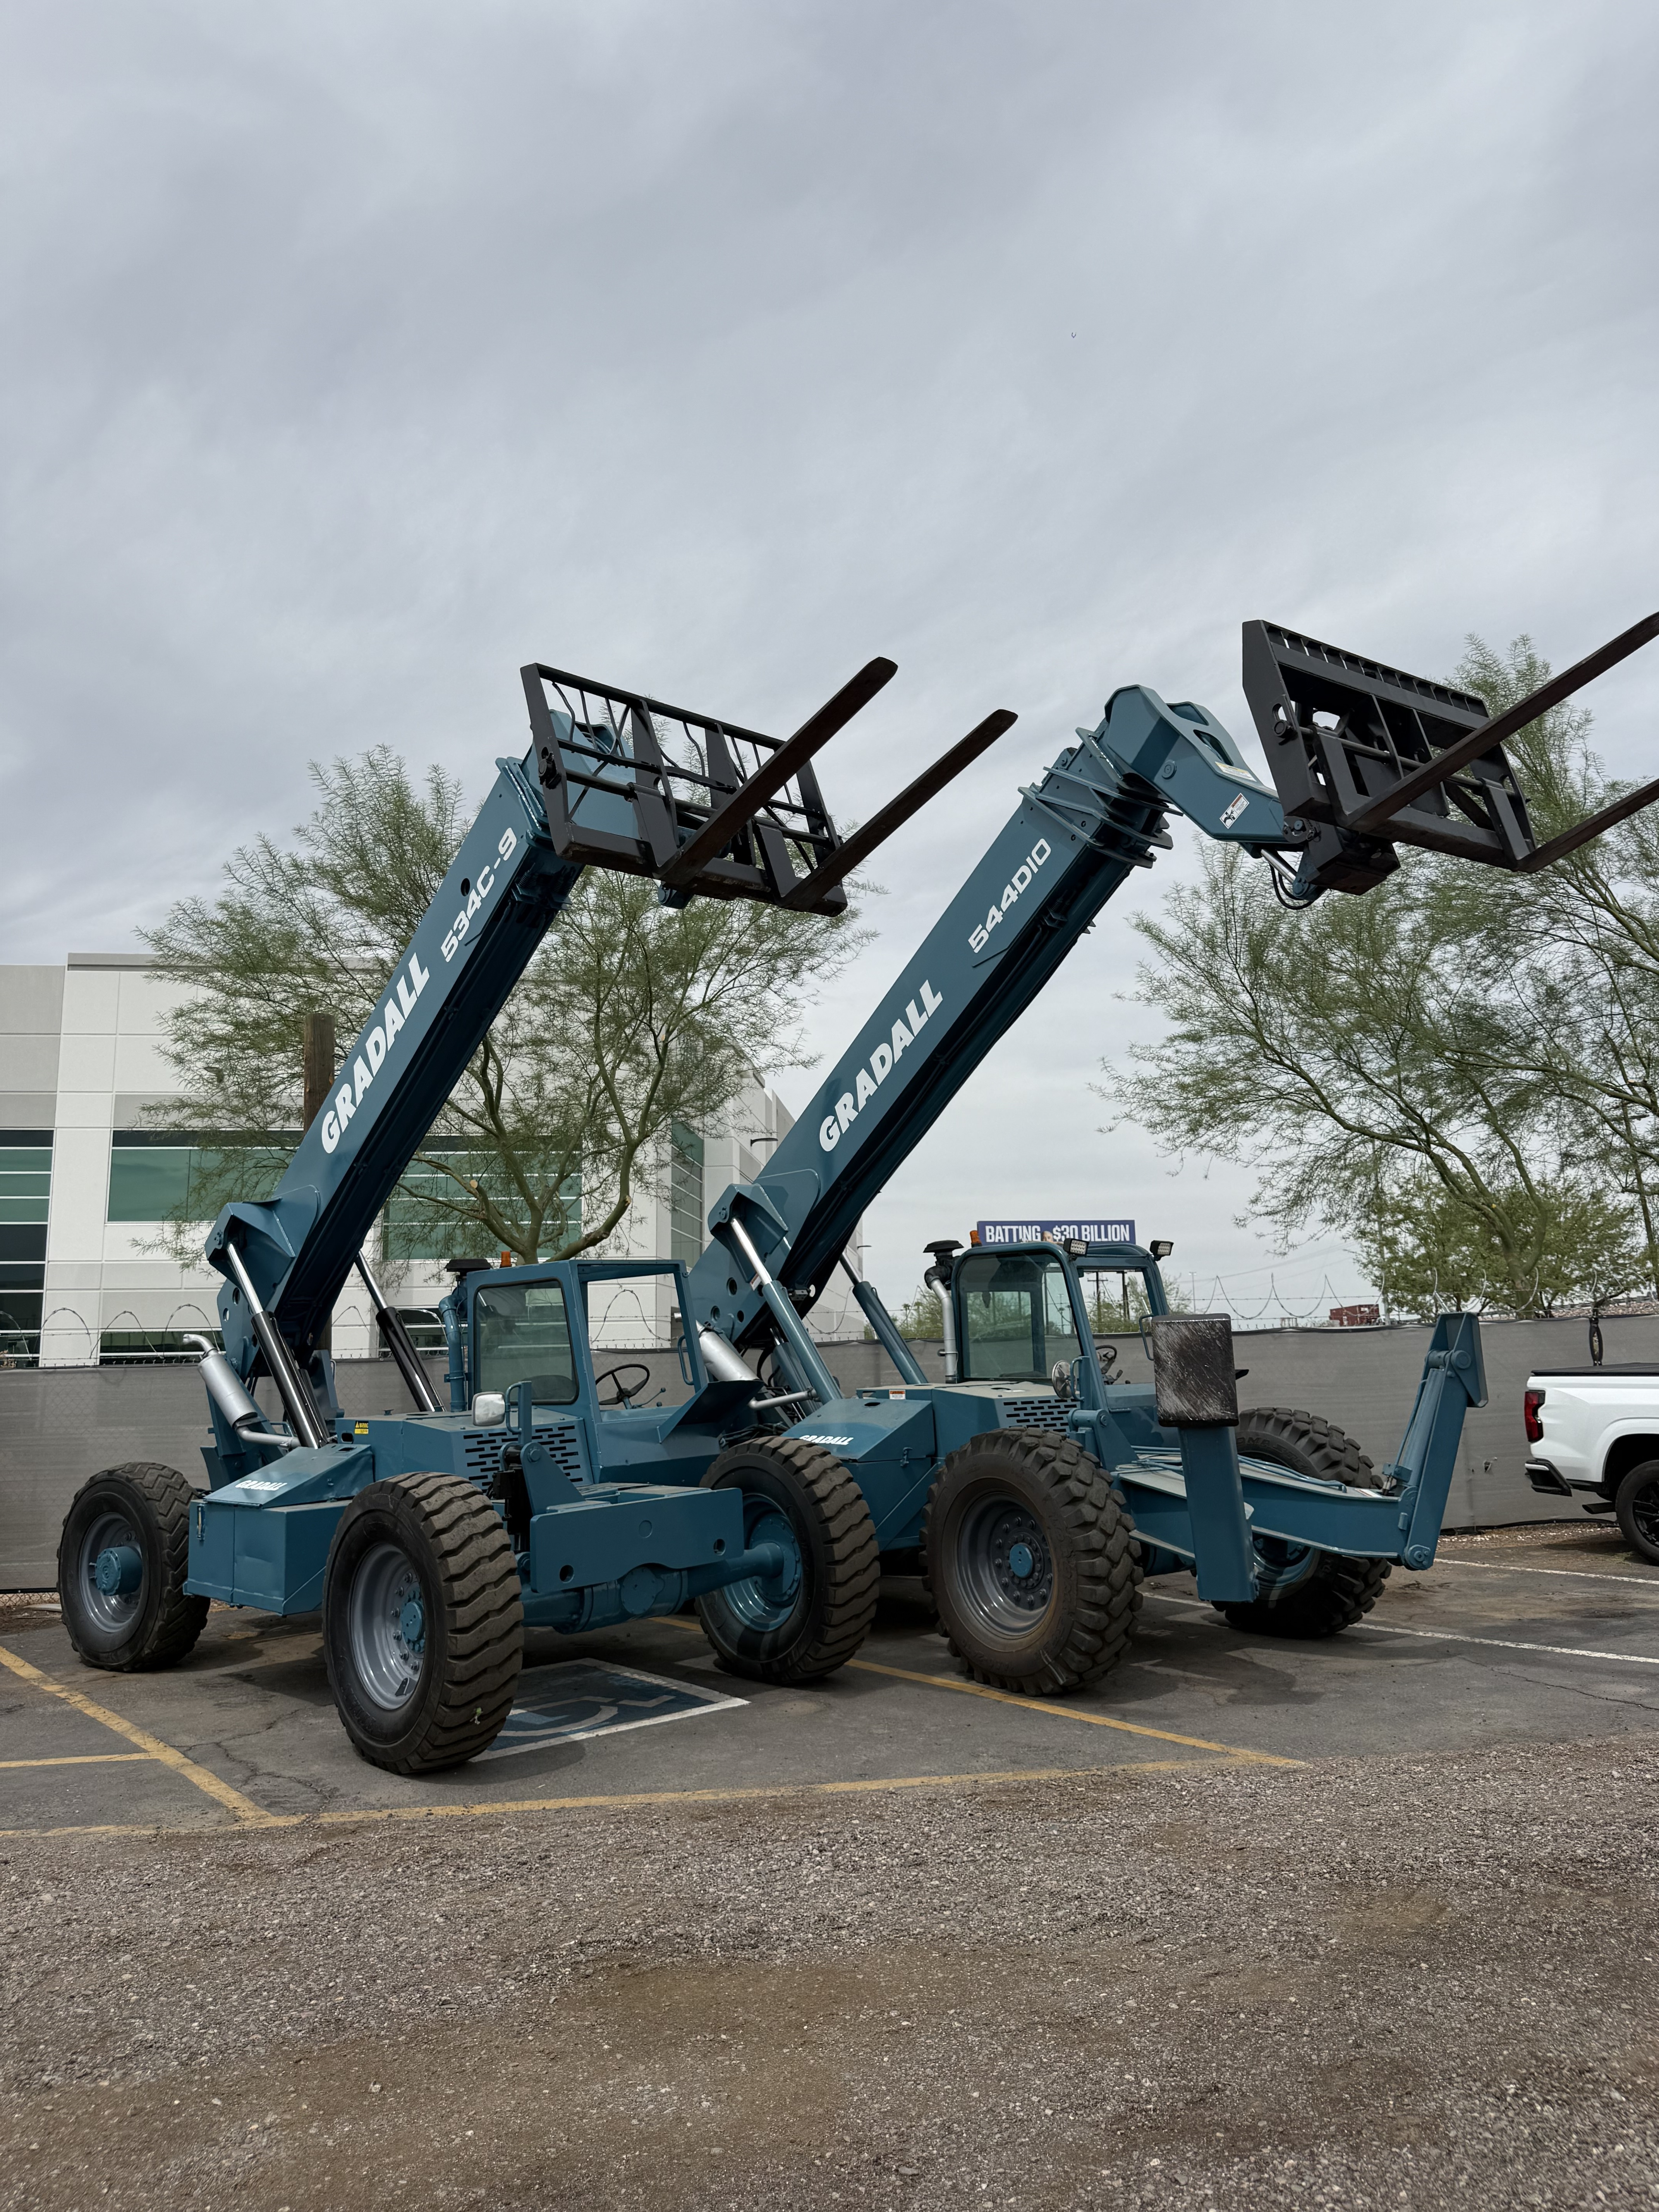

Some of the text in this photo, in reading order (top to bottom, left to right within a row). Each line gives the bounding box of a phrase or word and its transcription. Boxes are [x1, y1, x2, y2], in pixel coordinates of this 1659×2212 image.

[441, 827, 517, 962] 534C-9
[321, 952, 430, 1154] GRADALL
[819, 979, 943, 1152] GRADALL
[985, 1224, 1130, 1243] BATTING $30 BILLION
[235, 1480, 288, 1491] GRADALL
